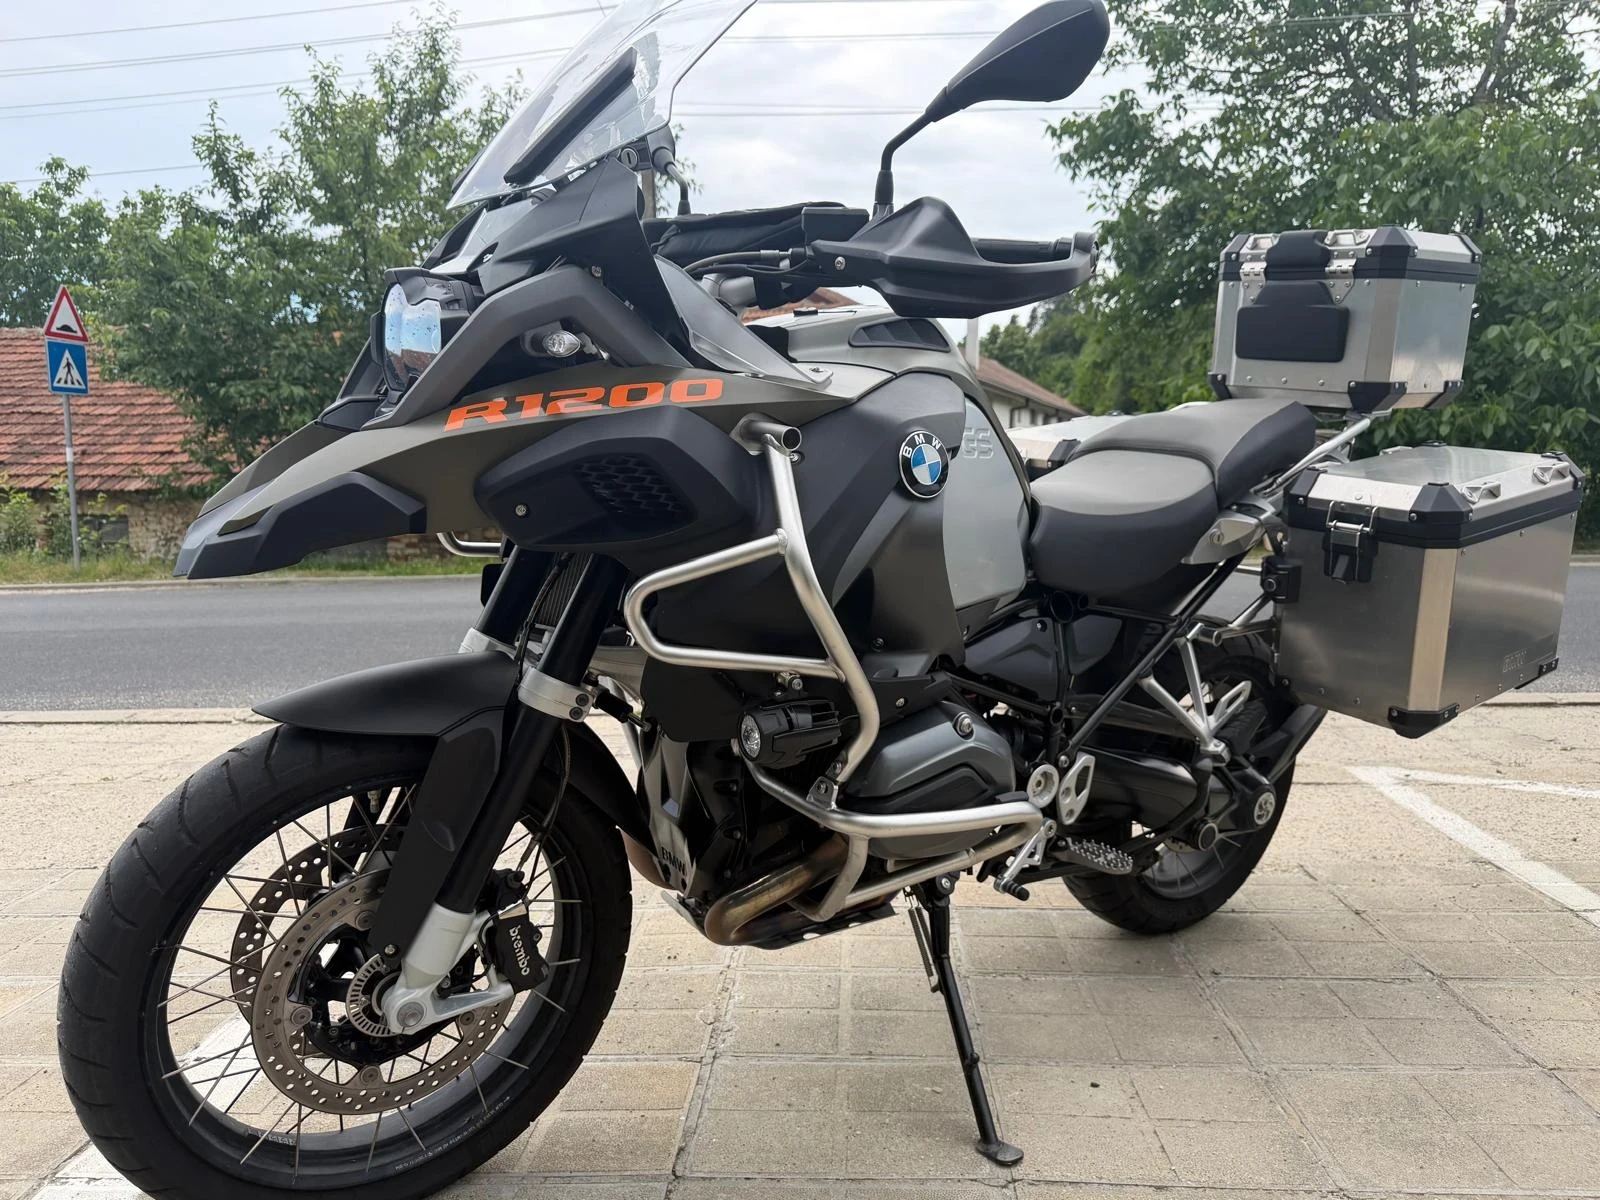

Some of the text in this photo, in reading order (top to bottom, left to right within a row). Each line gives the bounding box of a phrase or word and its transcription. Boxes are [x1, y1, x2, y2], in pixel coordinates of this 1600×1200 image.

[444, 378, 723, 432] R1200
[902, 433, 942, 459] BMW
[661, 846, 688, 876] BMW
[508, 925, 531, 976] brembo
